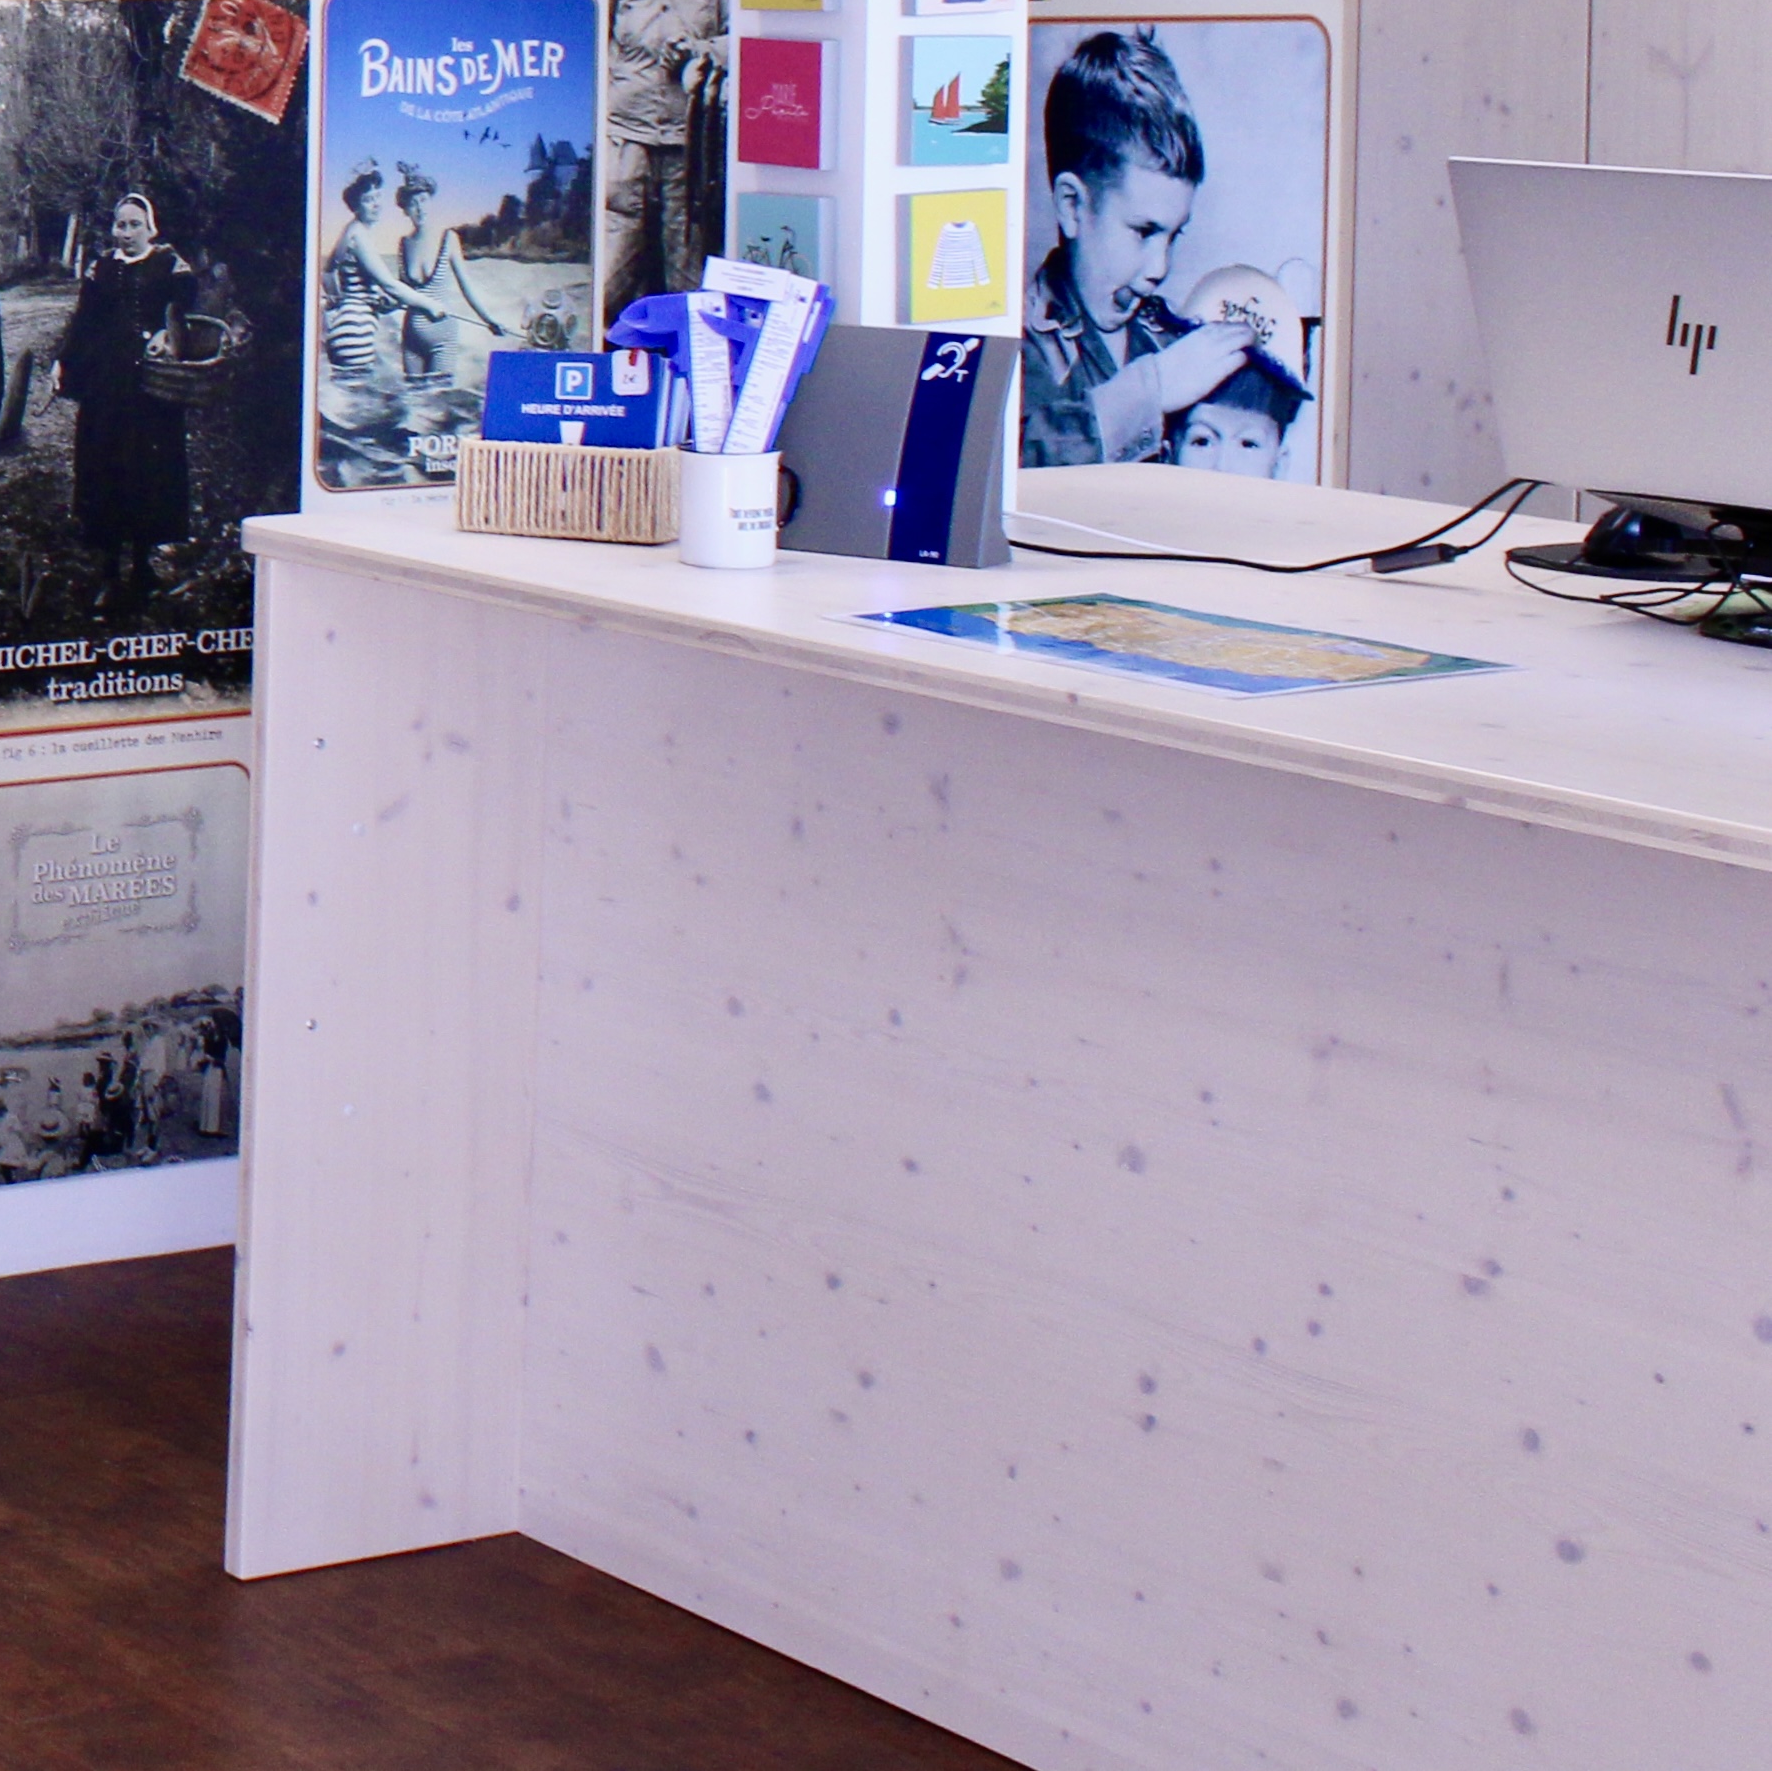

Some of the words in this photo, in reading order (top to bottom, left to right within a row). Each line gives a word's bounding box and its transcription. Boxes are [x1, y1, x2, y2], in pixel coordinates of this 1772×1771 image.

[451, 37, 473, 52] les
[359, 38, 457, 97] BAINS
[461, 53, 493, 86] DE
[480, 38, 565, 95] MER
[521, 402, 561, 416] HEURE
[563, 402, 626, 418] D'ARRIVÉE
[408, 434, 457, 458] POR
[47, 671, 184, 702] traditions
[51, 741, 67, 754] la
[73, 736, 141, 754] cueillette
[89, 833, 121, 855] Le
[32, 852, 177, 885] Phénomène
[32, 884, 65, 905] des
